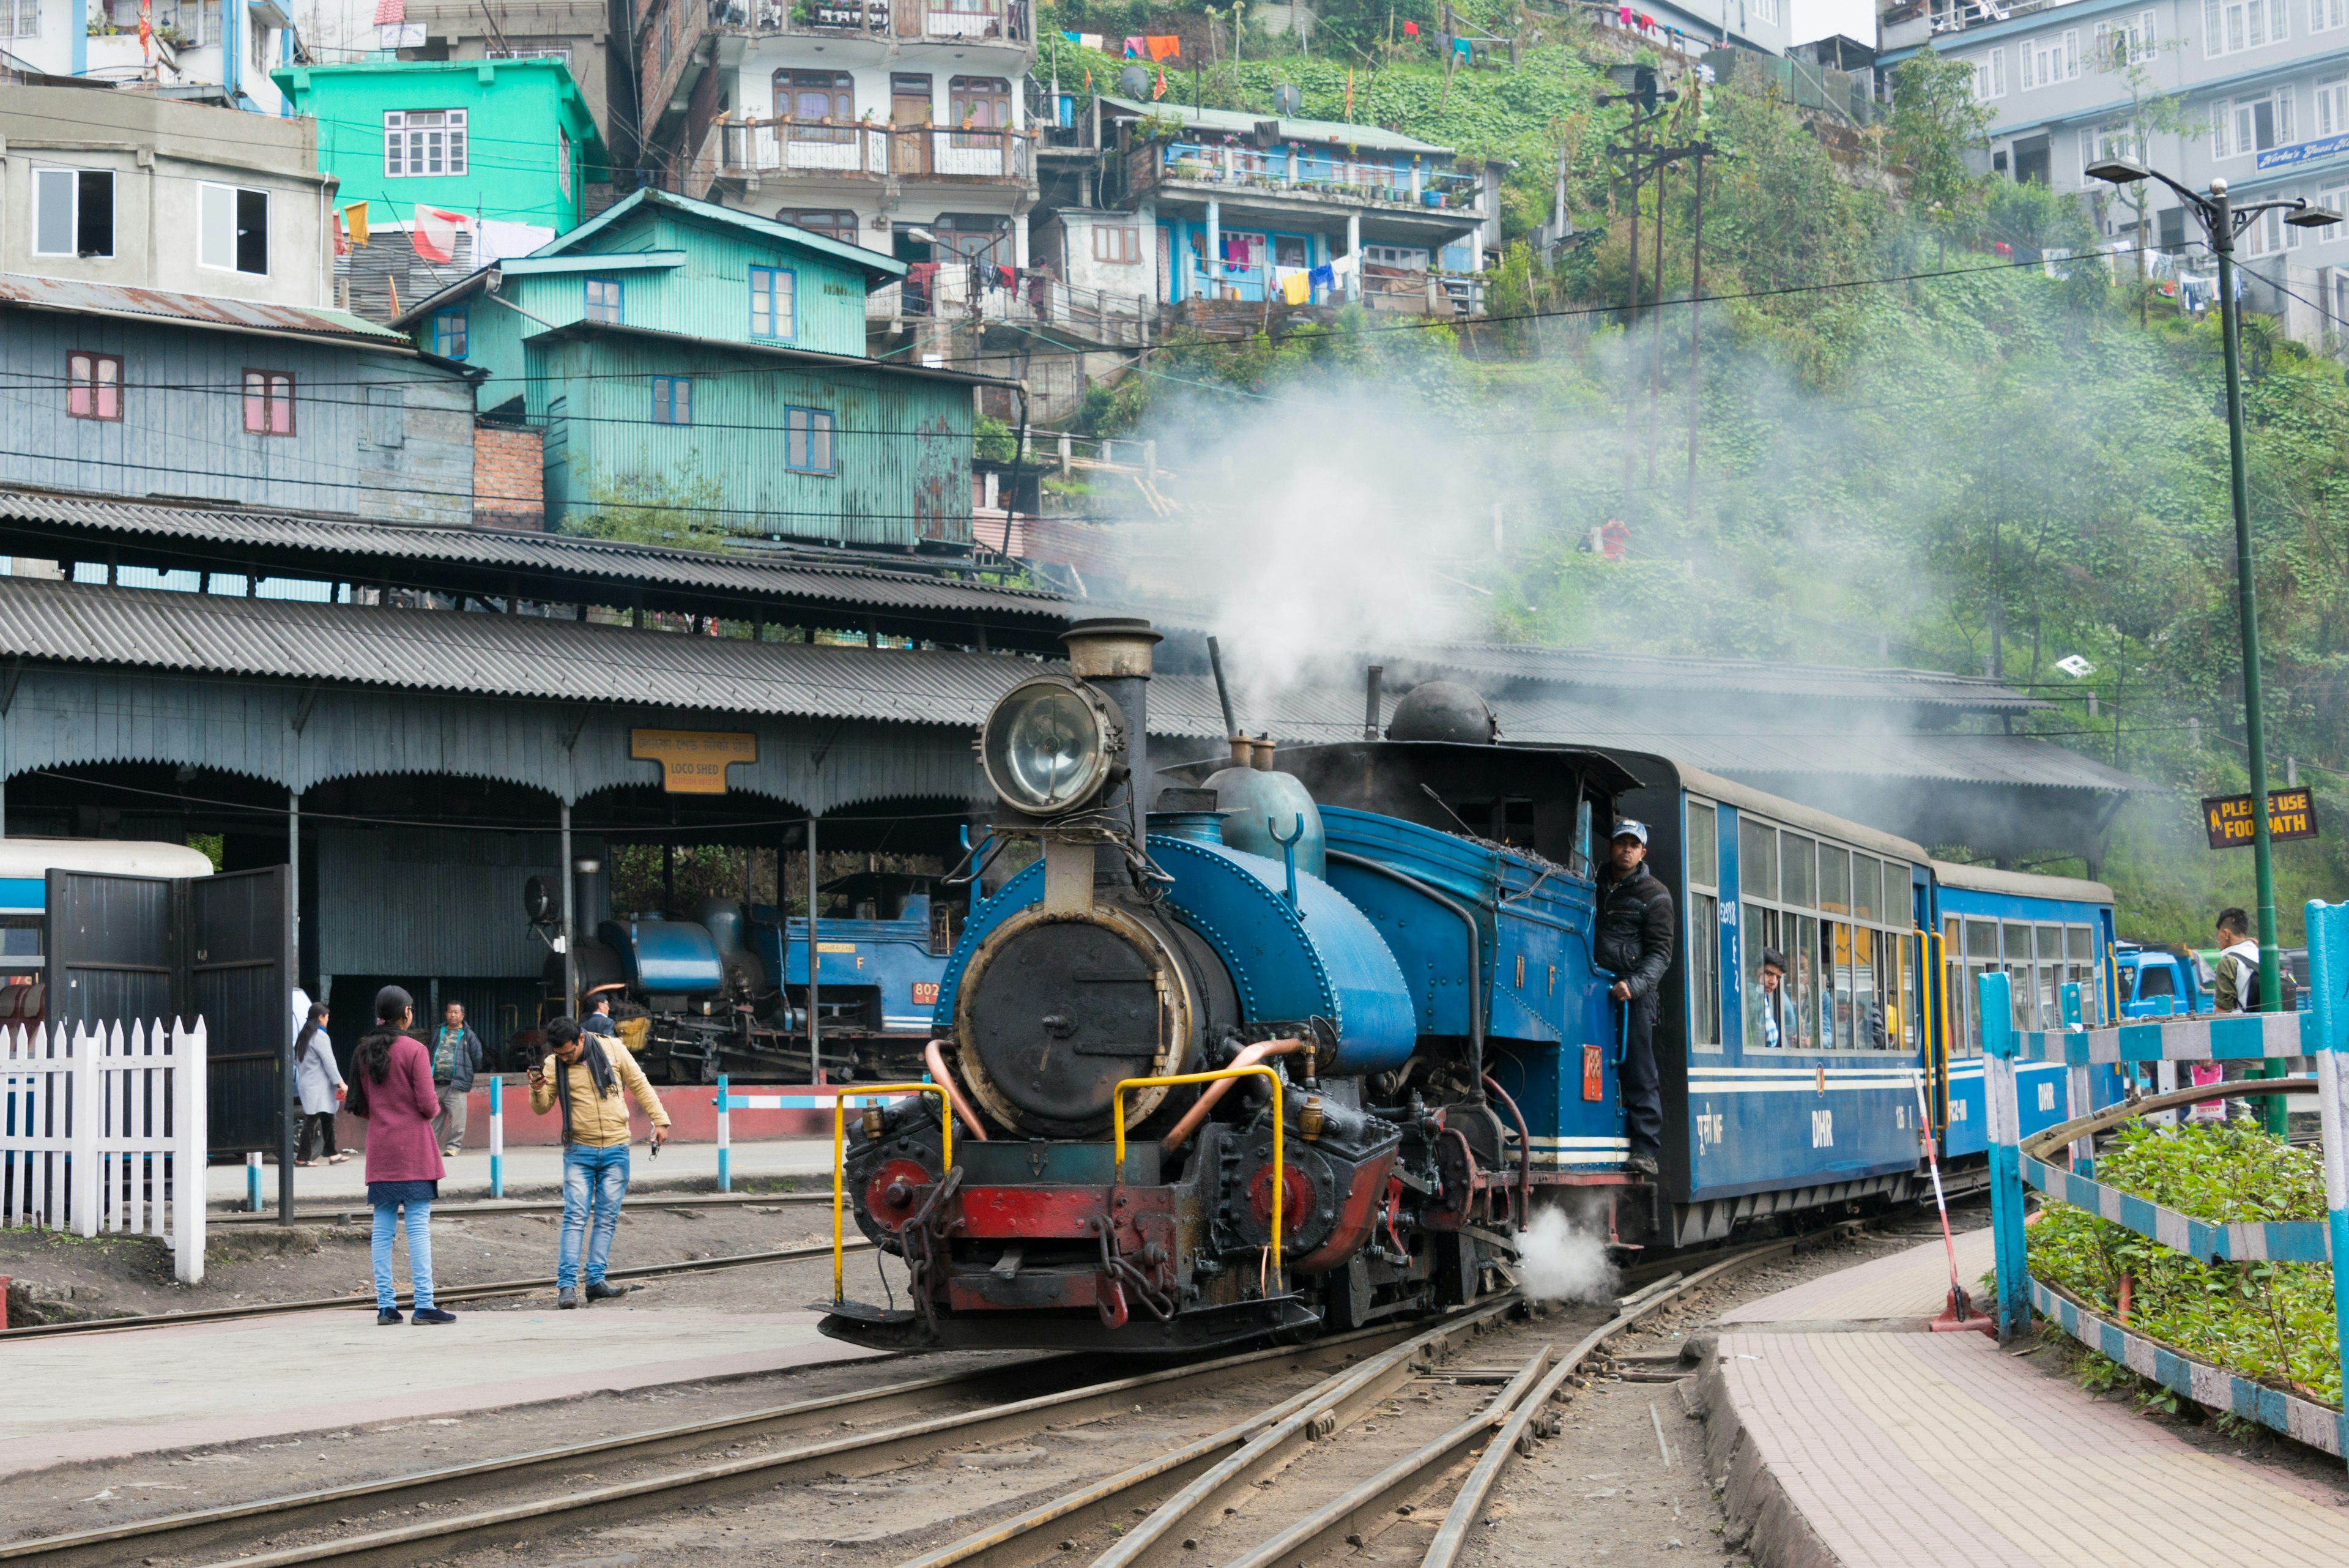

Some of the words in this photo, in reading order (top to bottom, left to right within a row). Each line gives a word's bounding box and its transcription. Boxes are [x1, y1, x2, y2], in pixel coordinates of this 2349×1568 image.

[2259, 149, 2300, 168] Norbu's
[2303, 143, 2334, 159] Guest
[671, 763, 694, 774] LOCO
[697, 764, 719, 775] SHED
[2277, 794, 2307, 811] USE
[916, 983, 940, 996] 802
[1516, 956, 1524, 989] N
[1548, 965, 1556, 997] F
[1586, 1047, 1601, 1079] 788
[2038, 1082, 2055, 1112] DHR
[1713, 1114, 1723, 1144] NF
[1811, 1110, 1834, 1148] DHR
